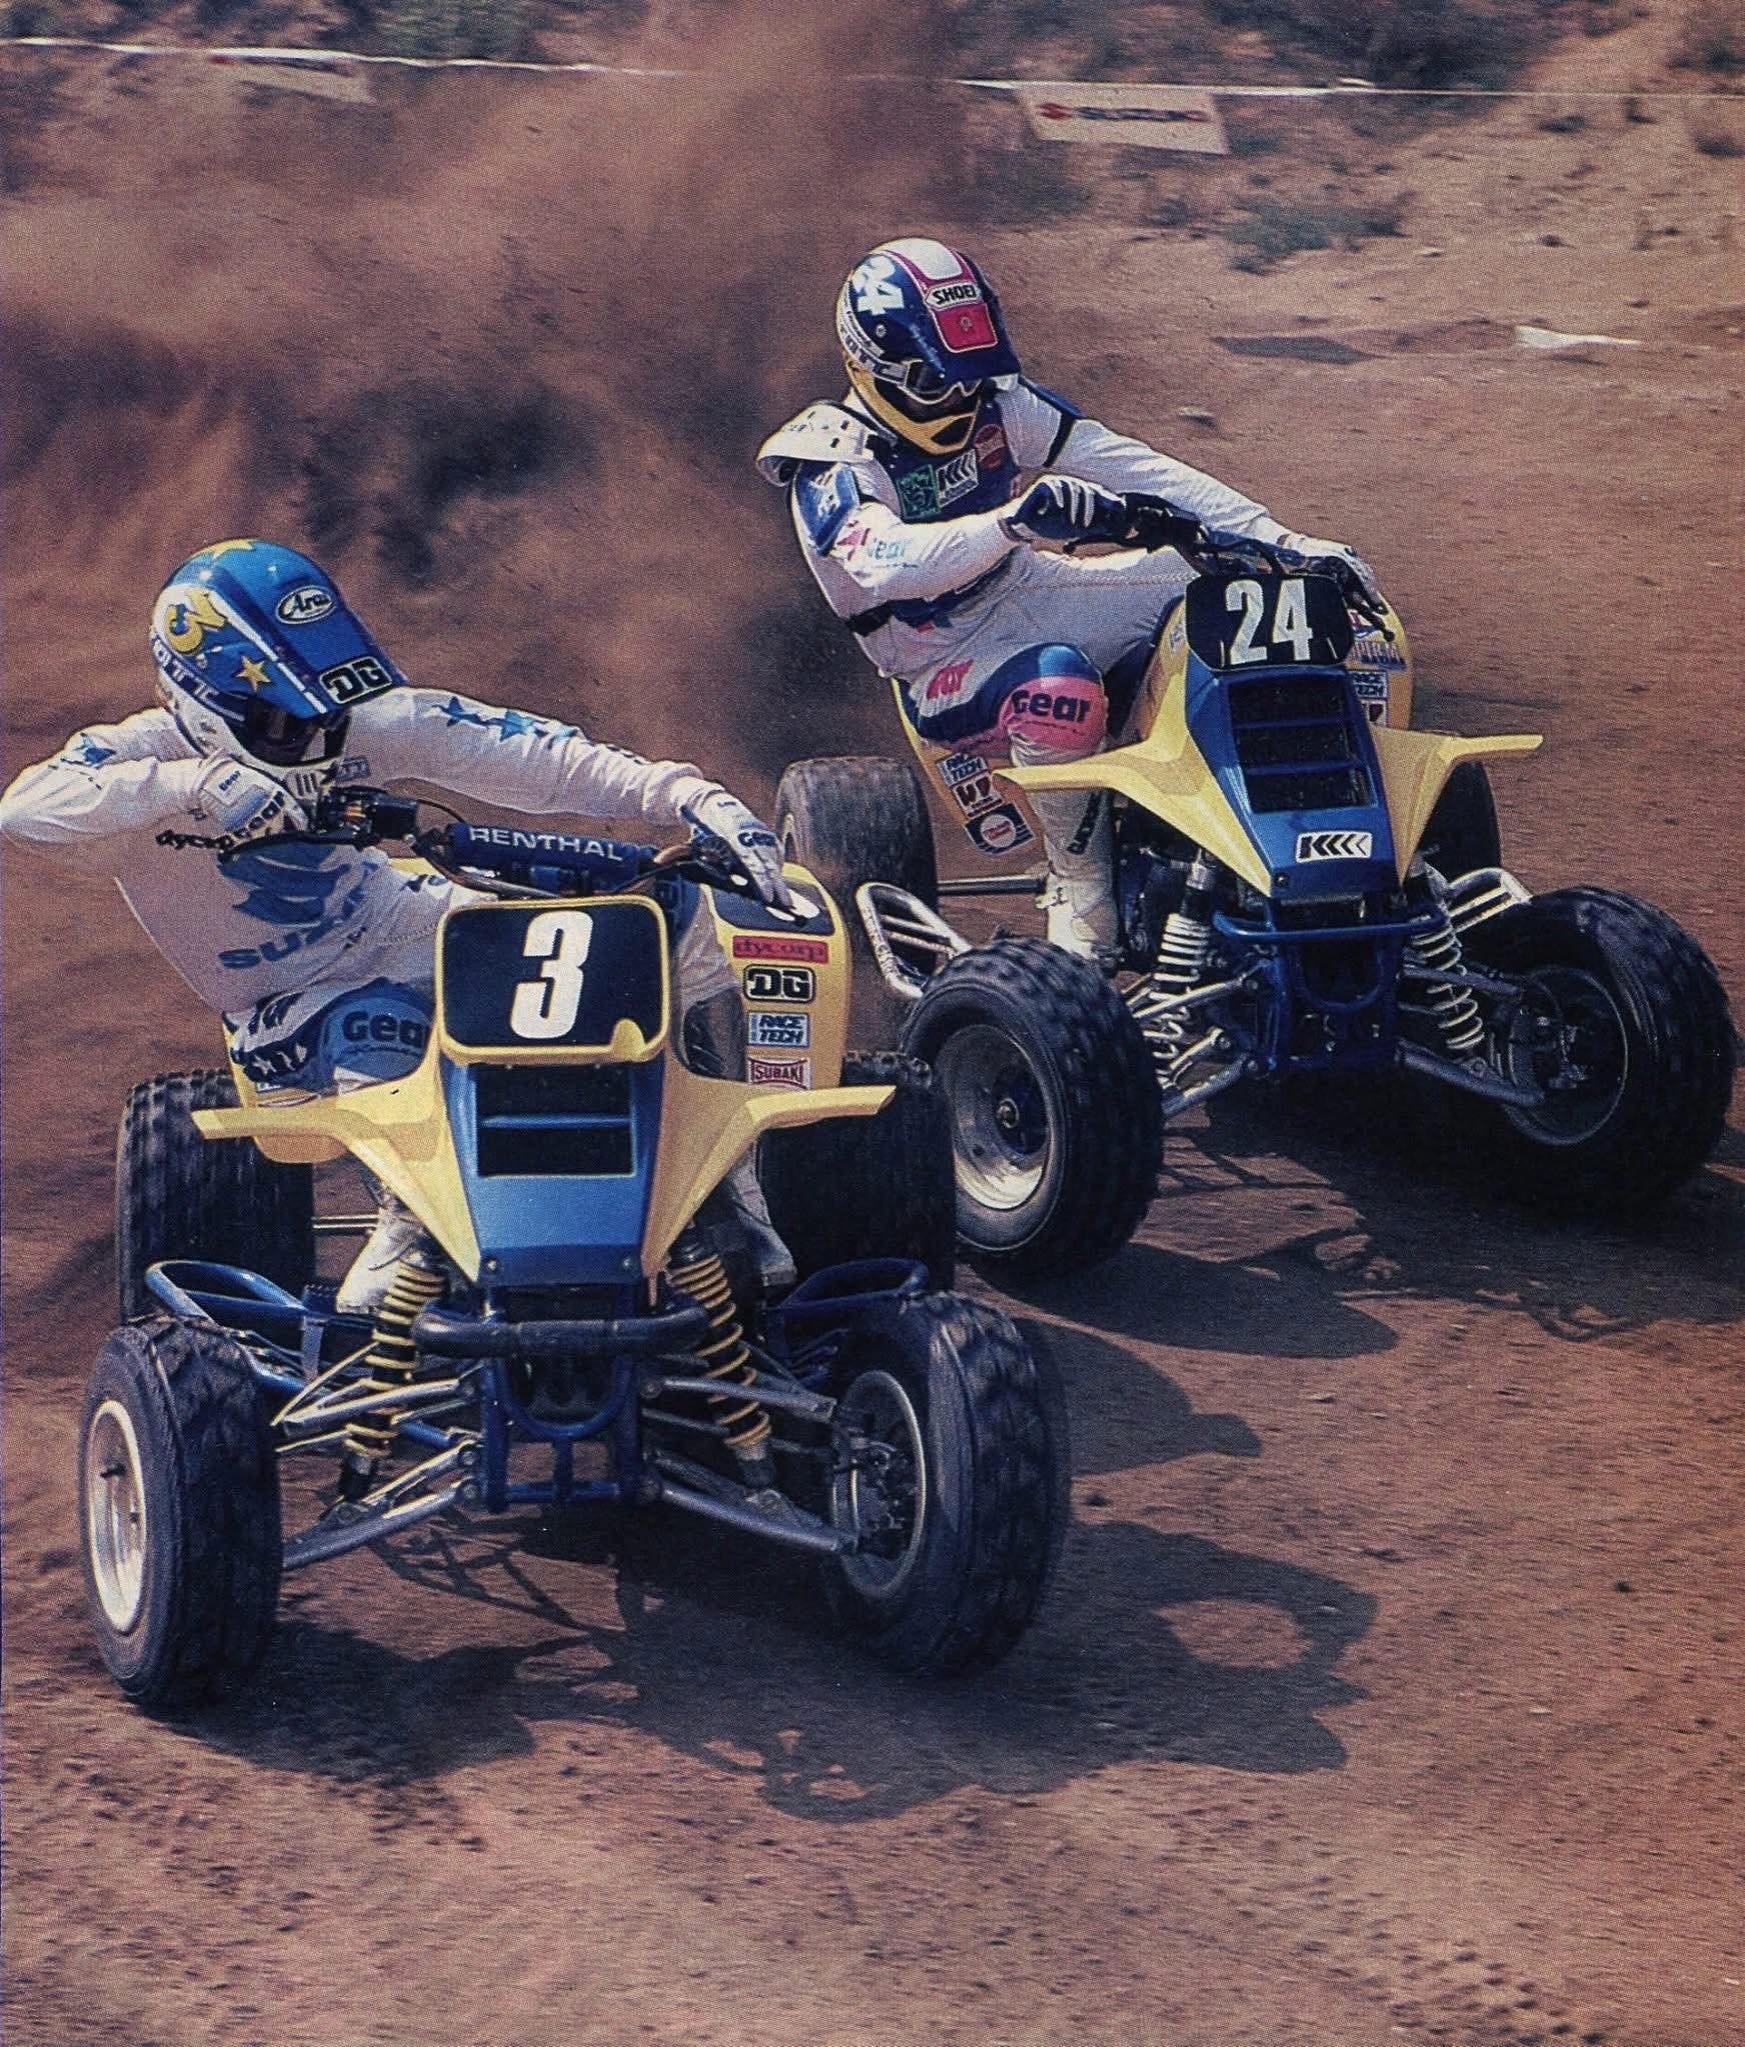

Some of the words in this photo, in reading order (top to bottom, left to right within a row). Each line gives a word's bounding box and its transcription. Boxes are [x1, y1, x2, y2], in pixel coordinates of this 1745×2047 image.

[932, 284, 978, 305] SHOEI
[1225, 577, 1314, 665] 24
[1010, 689, 1092, 722] Gear
[469, 826, 623, 861] RENTHAL
[510, 910, 593, 1039] 3
[748, 968, 811, 998] DG
[342, 1010, 428, 1049] Gea
